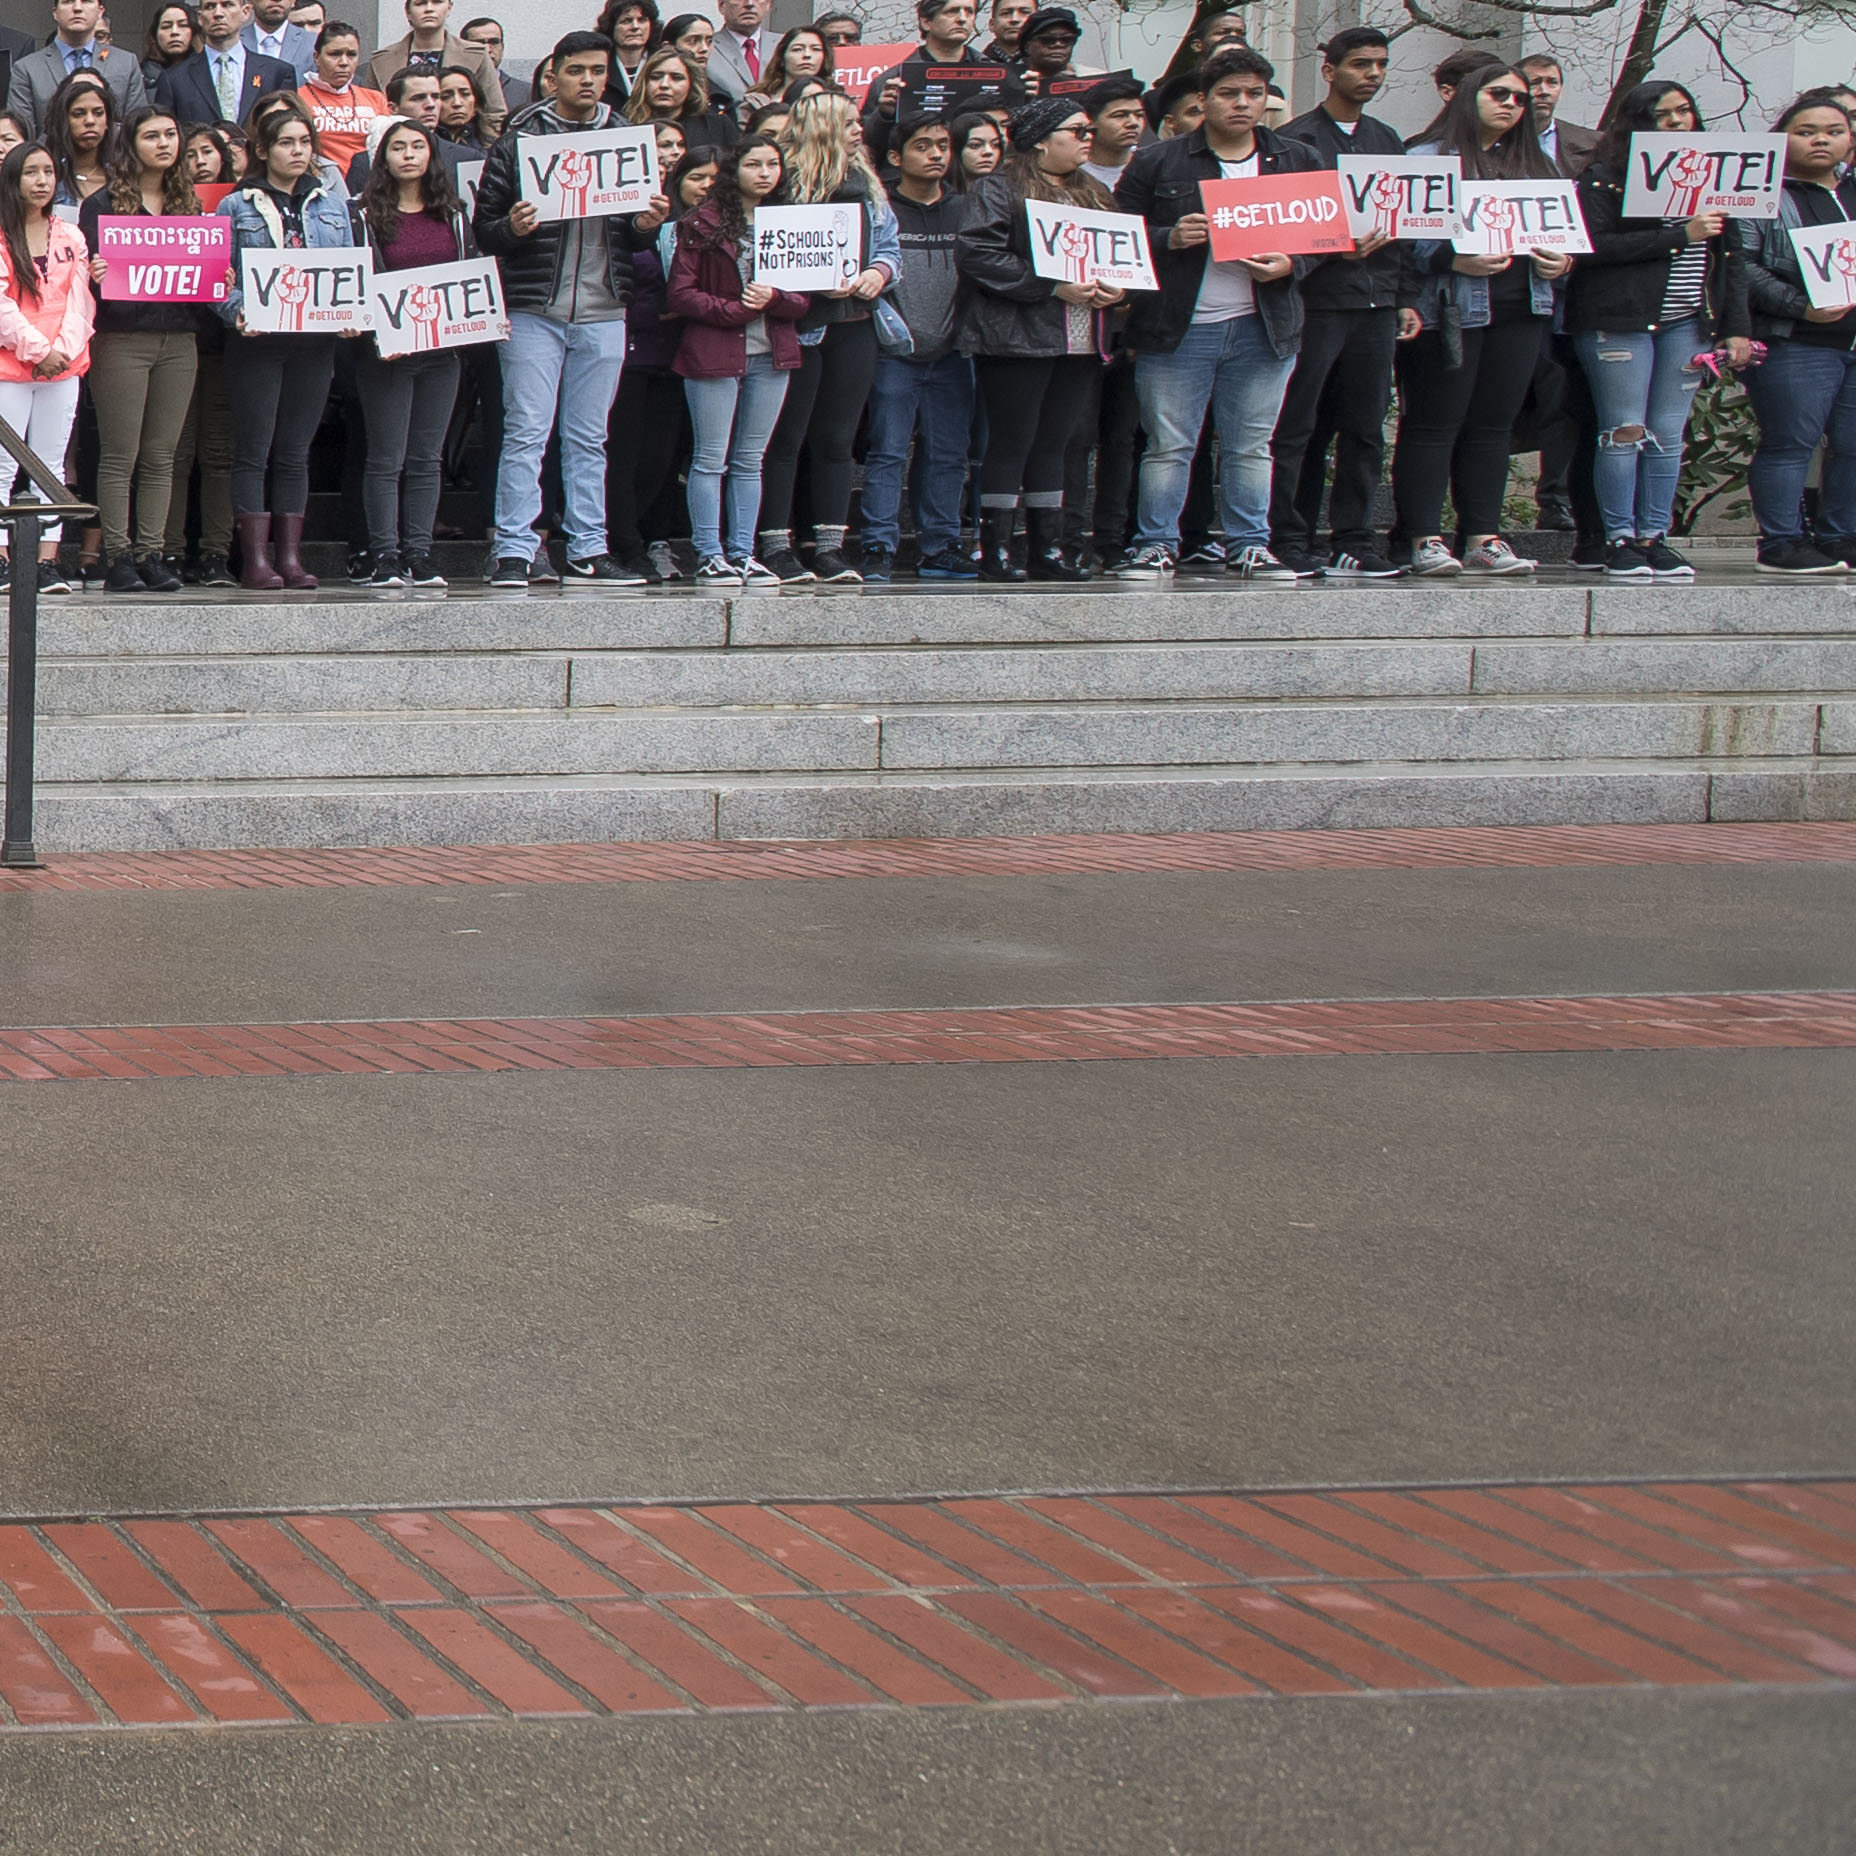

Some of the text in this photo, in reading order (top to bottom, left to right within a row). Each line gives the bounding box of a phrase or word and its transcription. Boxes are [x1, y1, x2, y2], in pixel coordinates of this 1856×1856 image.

[312, 105, 353, 118] WEAR
[313, 116, 369, 134] ORANG
[592, 189, 640, 204] #GETLOUD
[1705, 195, 1756, 206] #GETLOUD
[1211, 195, 1339, 229] #GETLOUD
[54, 246, 75, 263] LA
[128, 264, 202, 296] VOTE!
[308, 310, 353, 321] #GETLOUD
[444, 320, 487, 335] #GETLOUD
